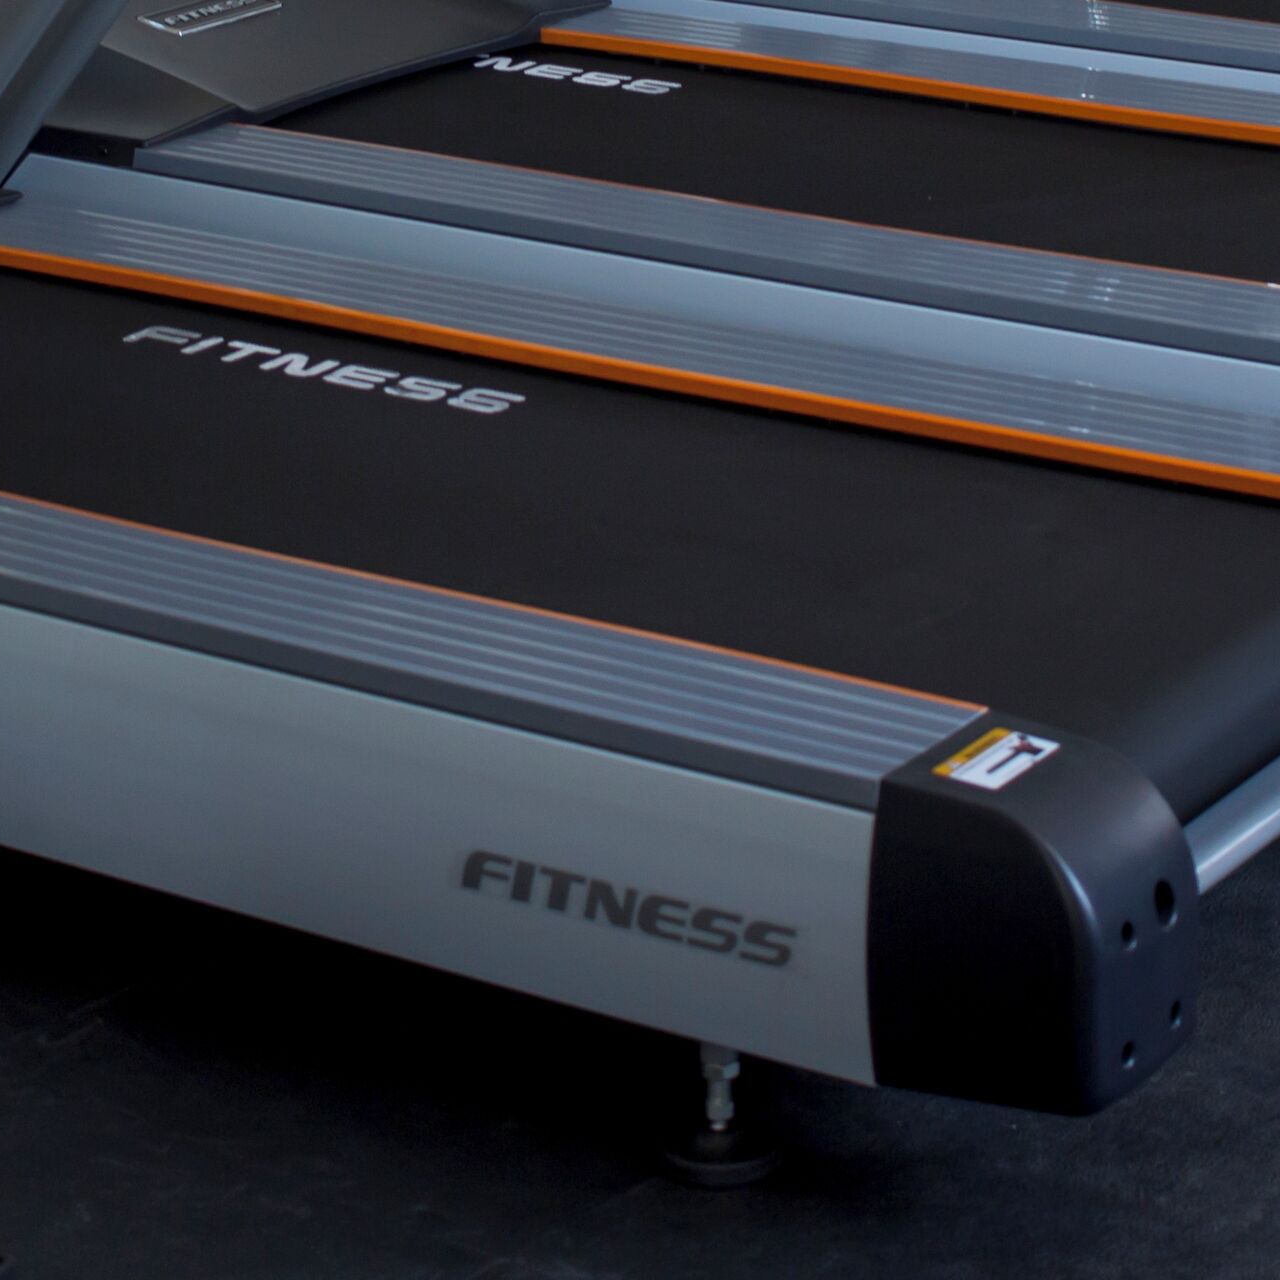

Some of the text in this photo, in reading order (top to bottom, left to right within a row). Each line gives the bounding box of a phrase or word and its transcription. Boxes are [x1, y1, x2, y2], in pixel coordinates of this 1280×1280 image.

[473, 54, 682, 95] NESS
[122, 324, 526, 414] FITNESS
[460, 849, 798, 968] FITNESS
